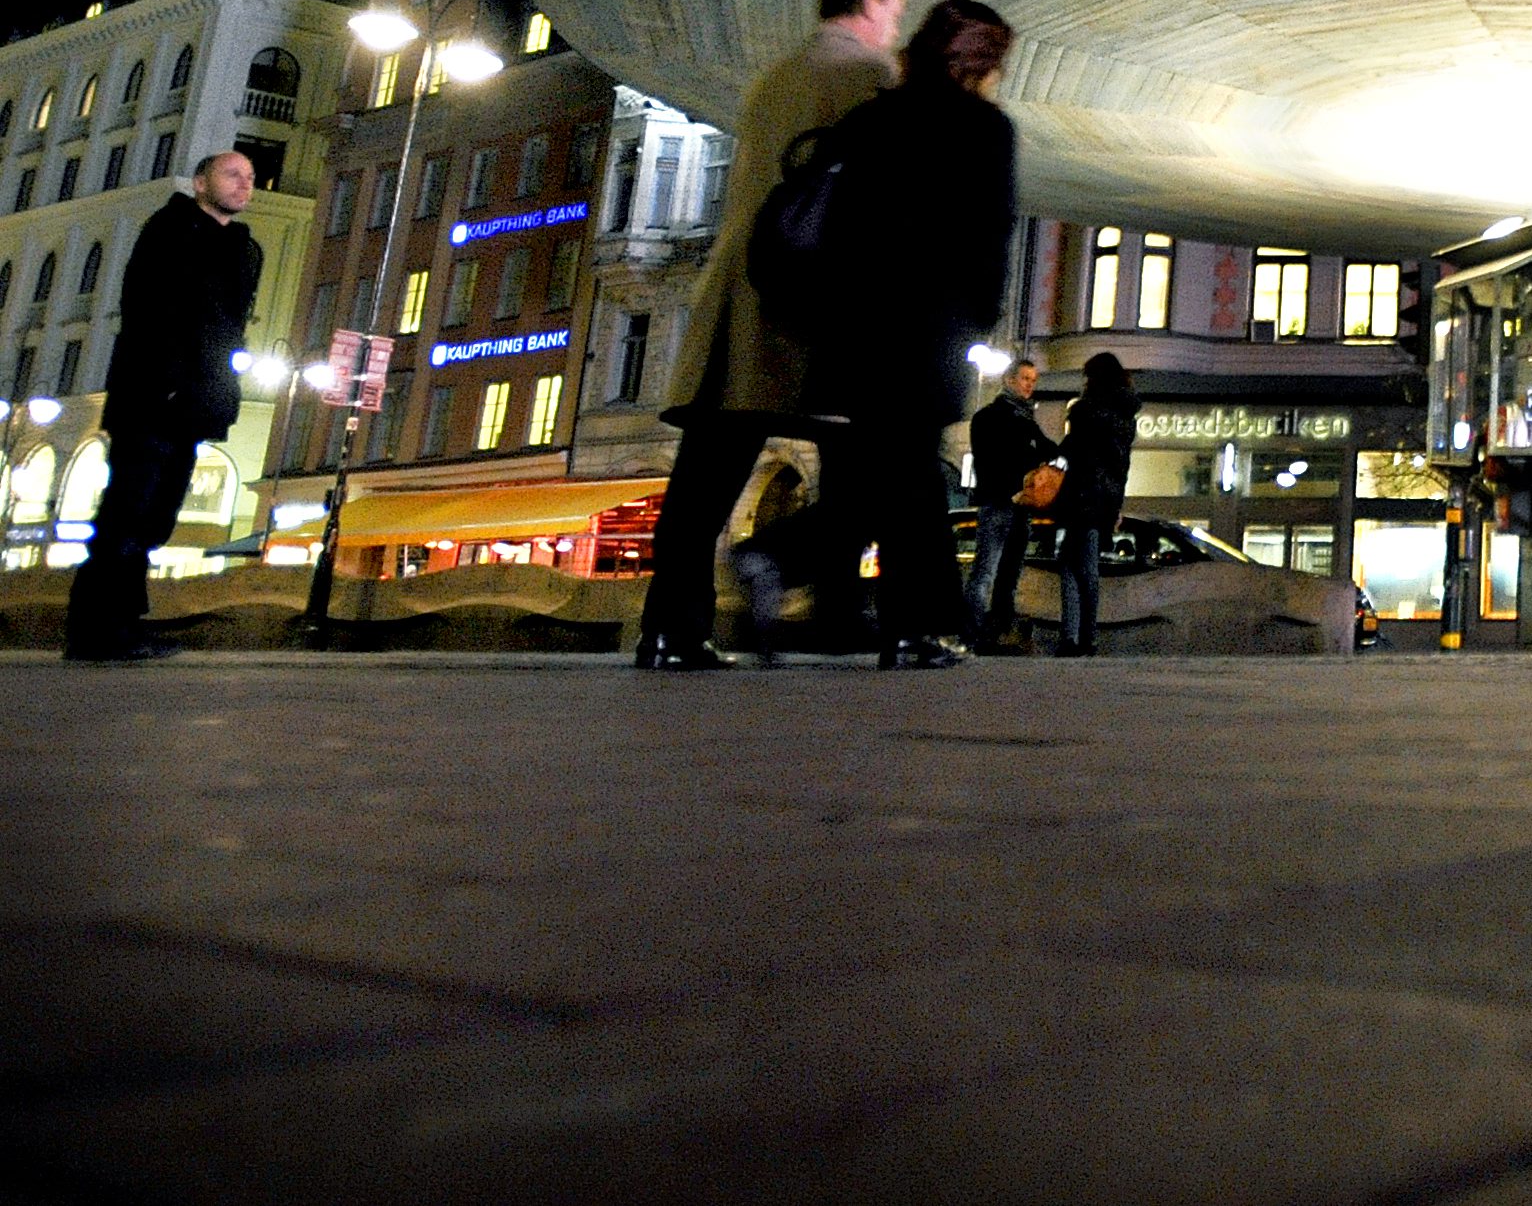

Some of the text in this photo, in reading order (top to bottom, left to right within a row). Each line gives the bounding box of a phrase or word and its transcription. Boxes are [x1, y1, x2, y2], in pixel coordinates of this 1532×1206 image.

[467, 204, 587, 238] KAUPTHING BANK
[447, 330, 569, 360] KAUPTHING BANK
[1134, 406, 1350, 437] ostadsbutiken
